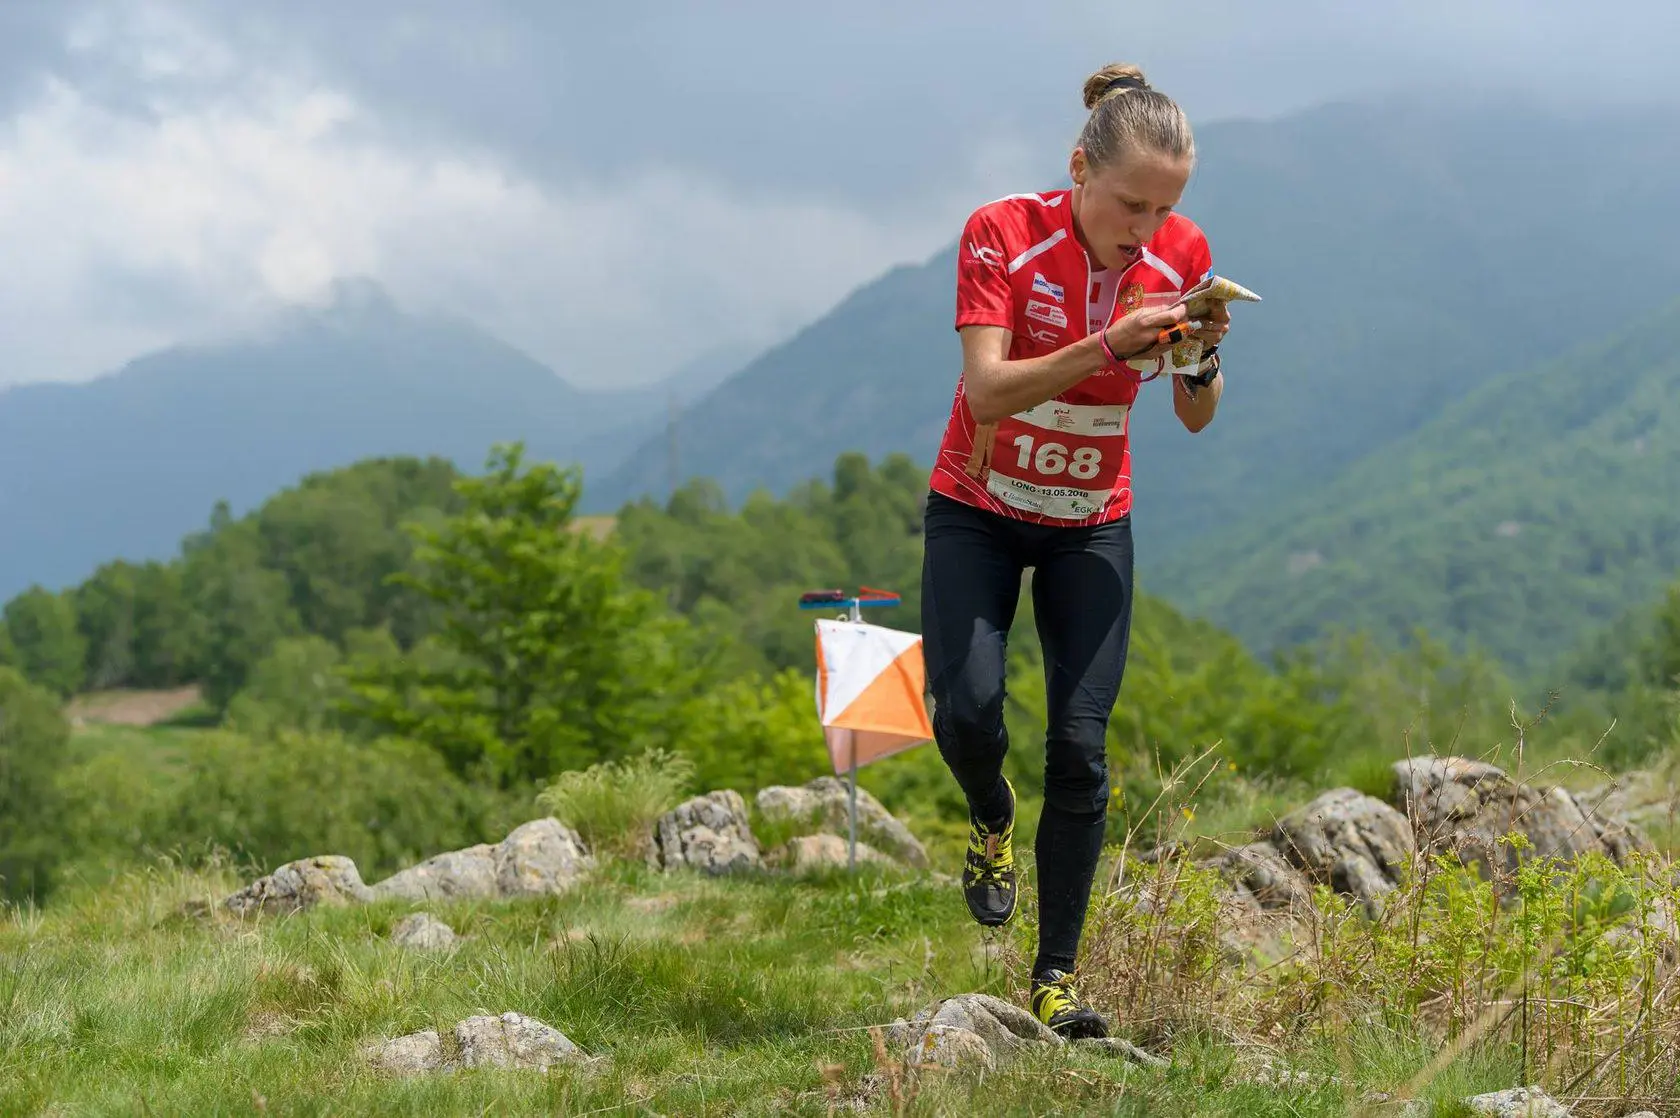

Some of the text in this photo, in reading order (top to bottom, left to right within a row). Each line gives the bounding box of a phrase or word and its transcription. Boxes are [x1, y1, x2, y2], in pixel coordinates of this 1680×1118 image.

[1013, 434, 1102, 480] 168
[1011, 480, 1036, 493] LONG
[1042, 489, 1089, 498] 13.05.2018
[1074, 506, 1093, 514] EGK
